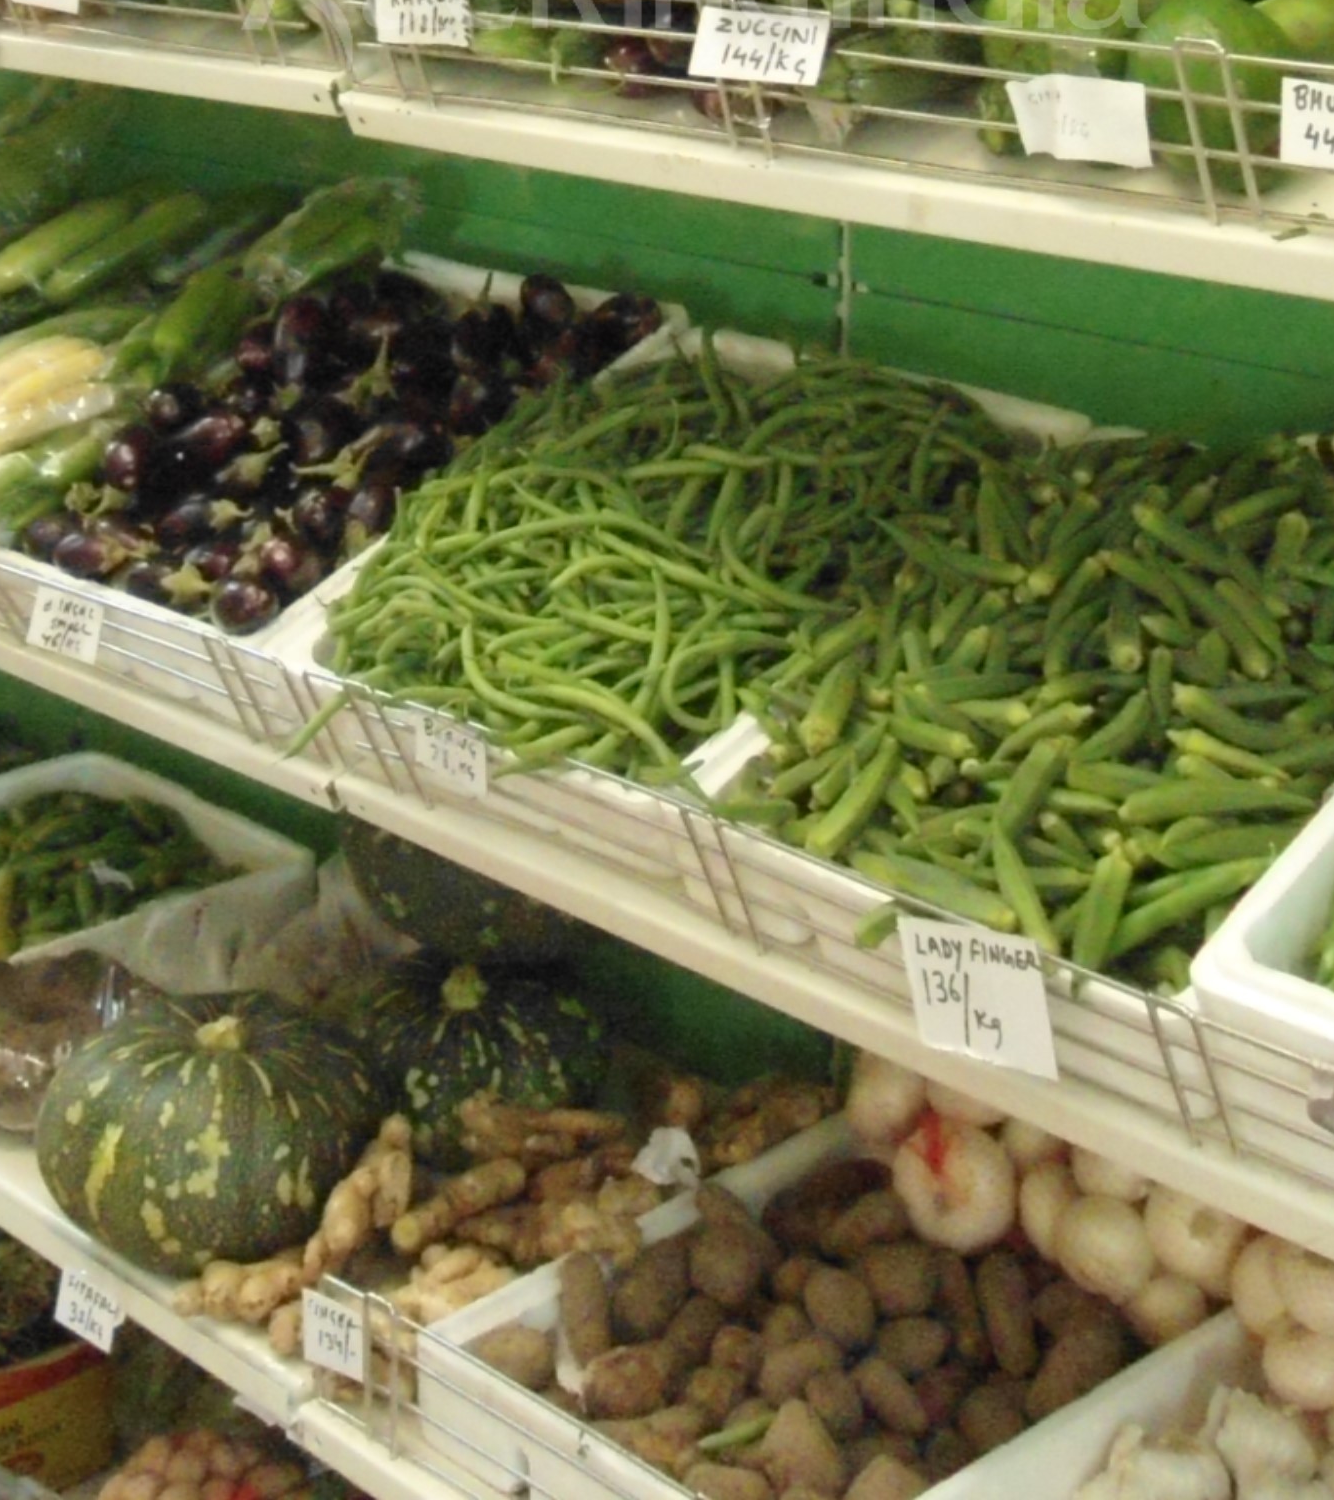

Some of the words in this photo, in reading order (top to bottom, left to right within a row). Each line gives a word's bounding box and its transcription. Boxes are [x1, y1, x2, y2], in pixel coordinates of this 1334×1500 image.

[714, 17, 817, 46] ZUCCINI
[915, 933, 963, 973] LADY
[969, 938, 1042, 972] FINGER
